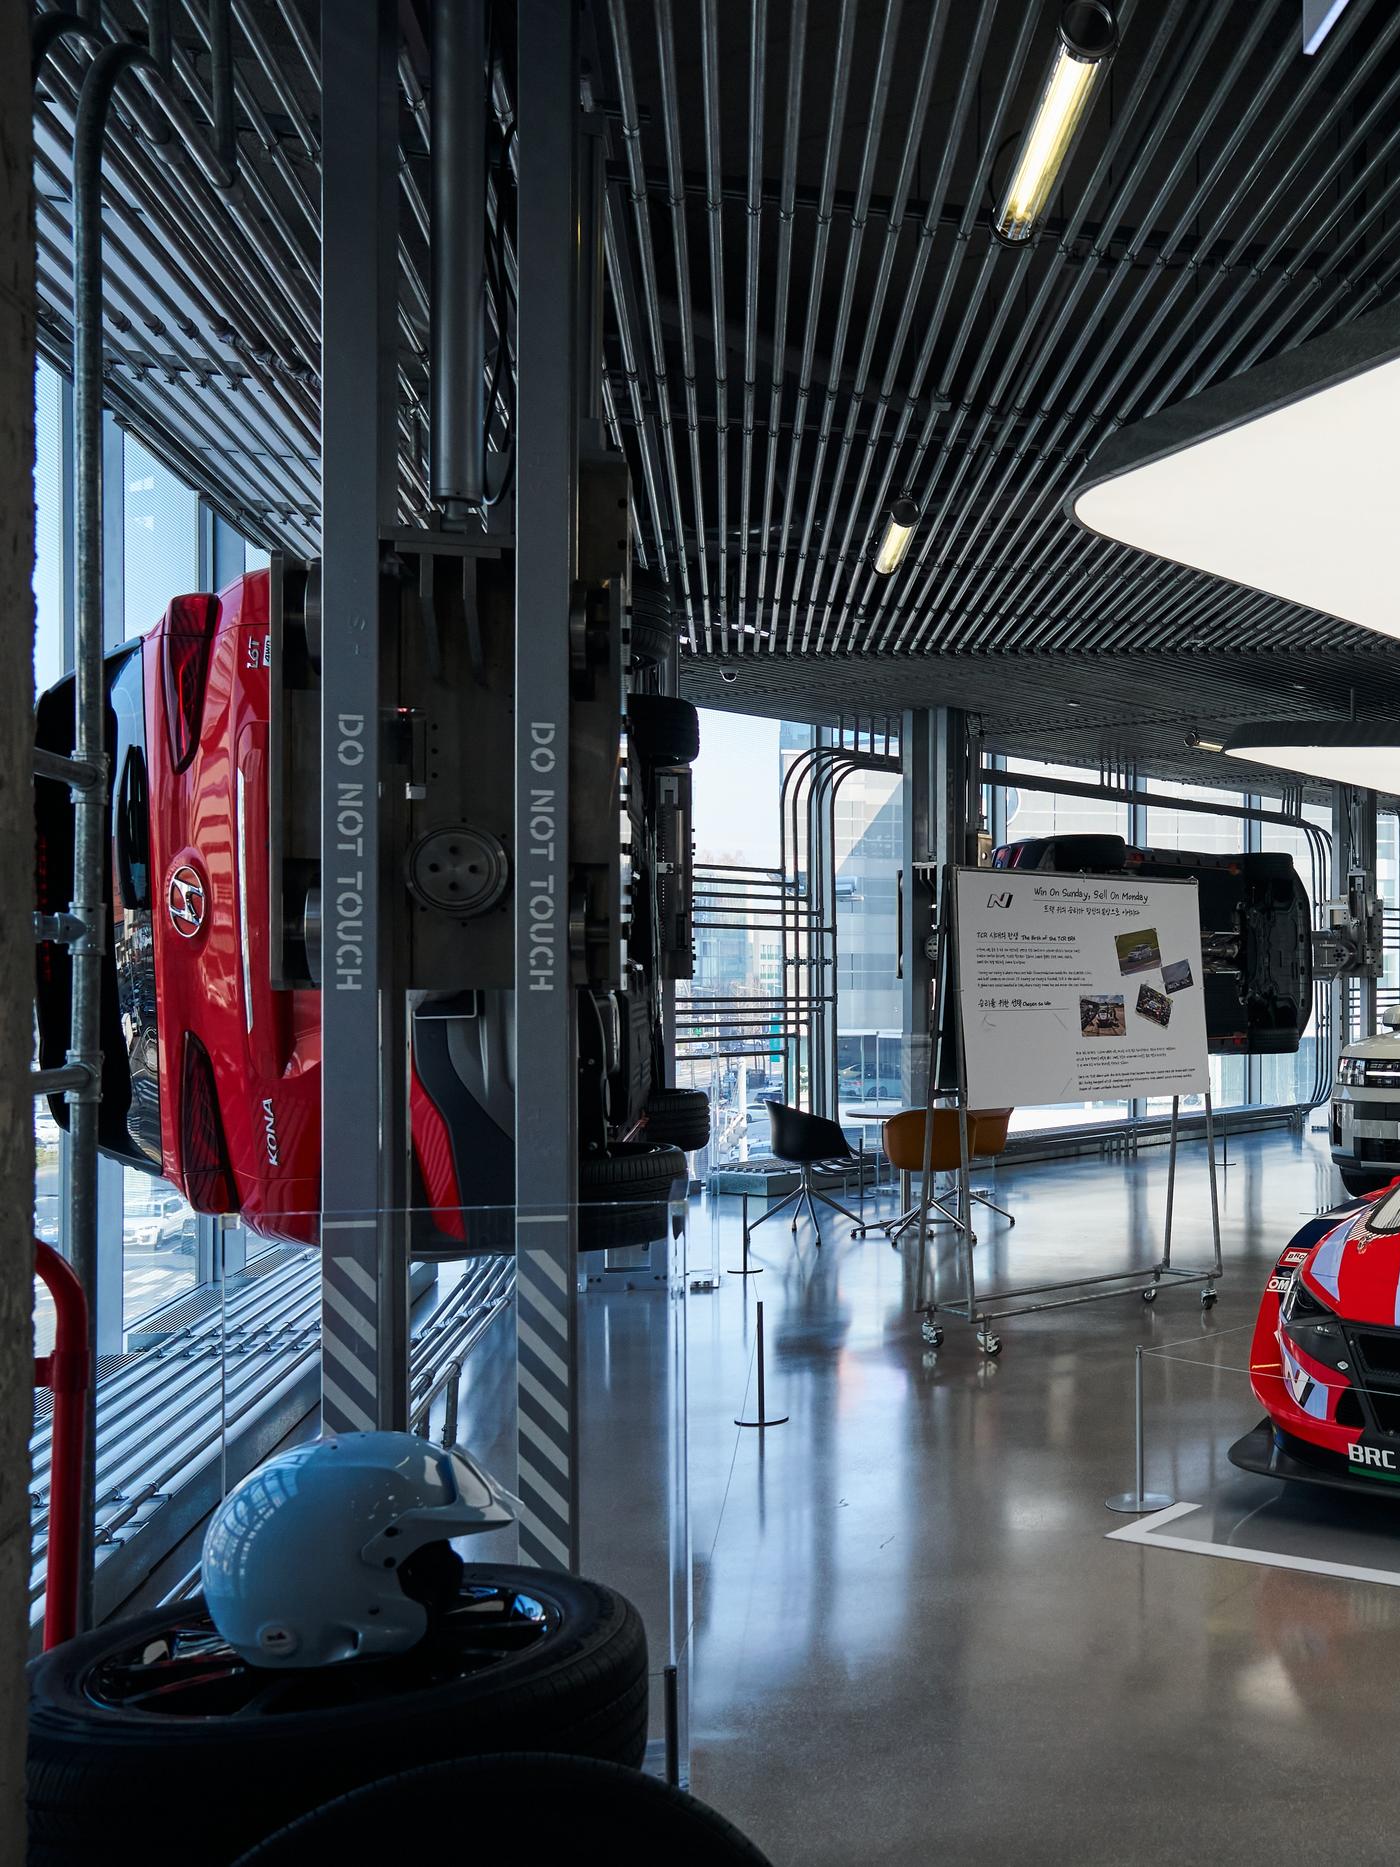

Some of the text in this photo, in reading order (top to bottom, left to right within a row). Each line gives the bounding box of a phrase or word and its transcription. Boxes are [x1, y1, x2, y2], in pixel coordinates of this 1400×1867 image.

[335, 713, 365, 991] DO NOT TOUCH
[529, 722, 556, 991] DO NOT TOUCH
[1034, 887, 1148, 904] Win On Sunday, Sell On Monday
[262, 1098, 278, 1166] KONA
[1268, 1279, 1290, 1290] OM
[1348, 1442, 1397, 1469] BRC
